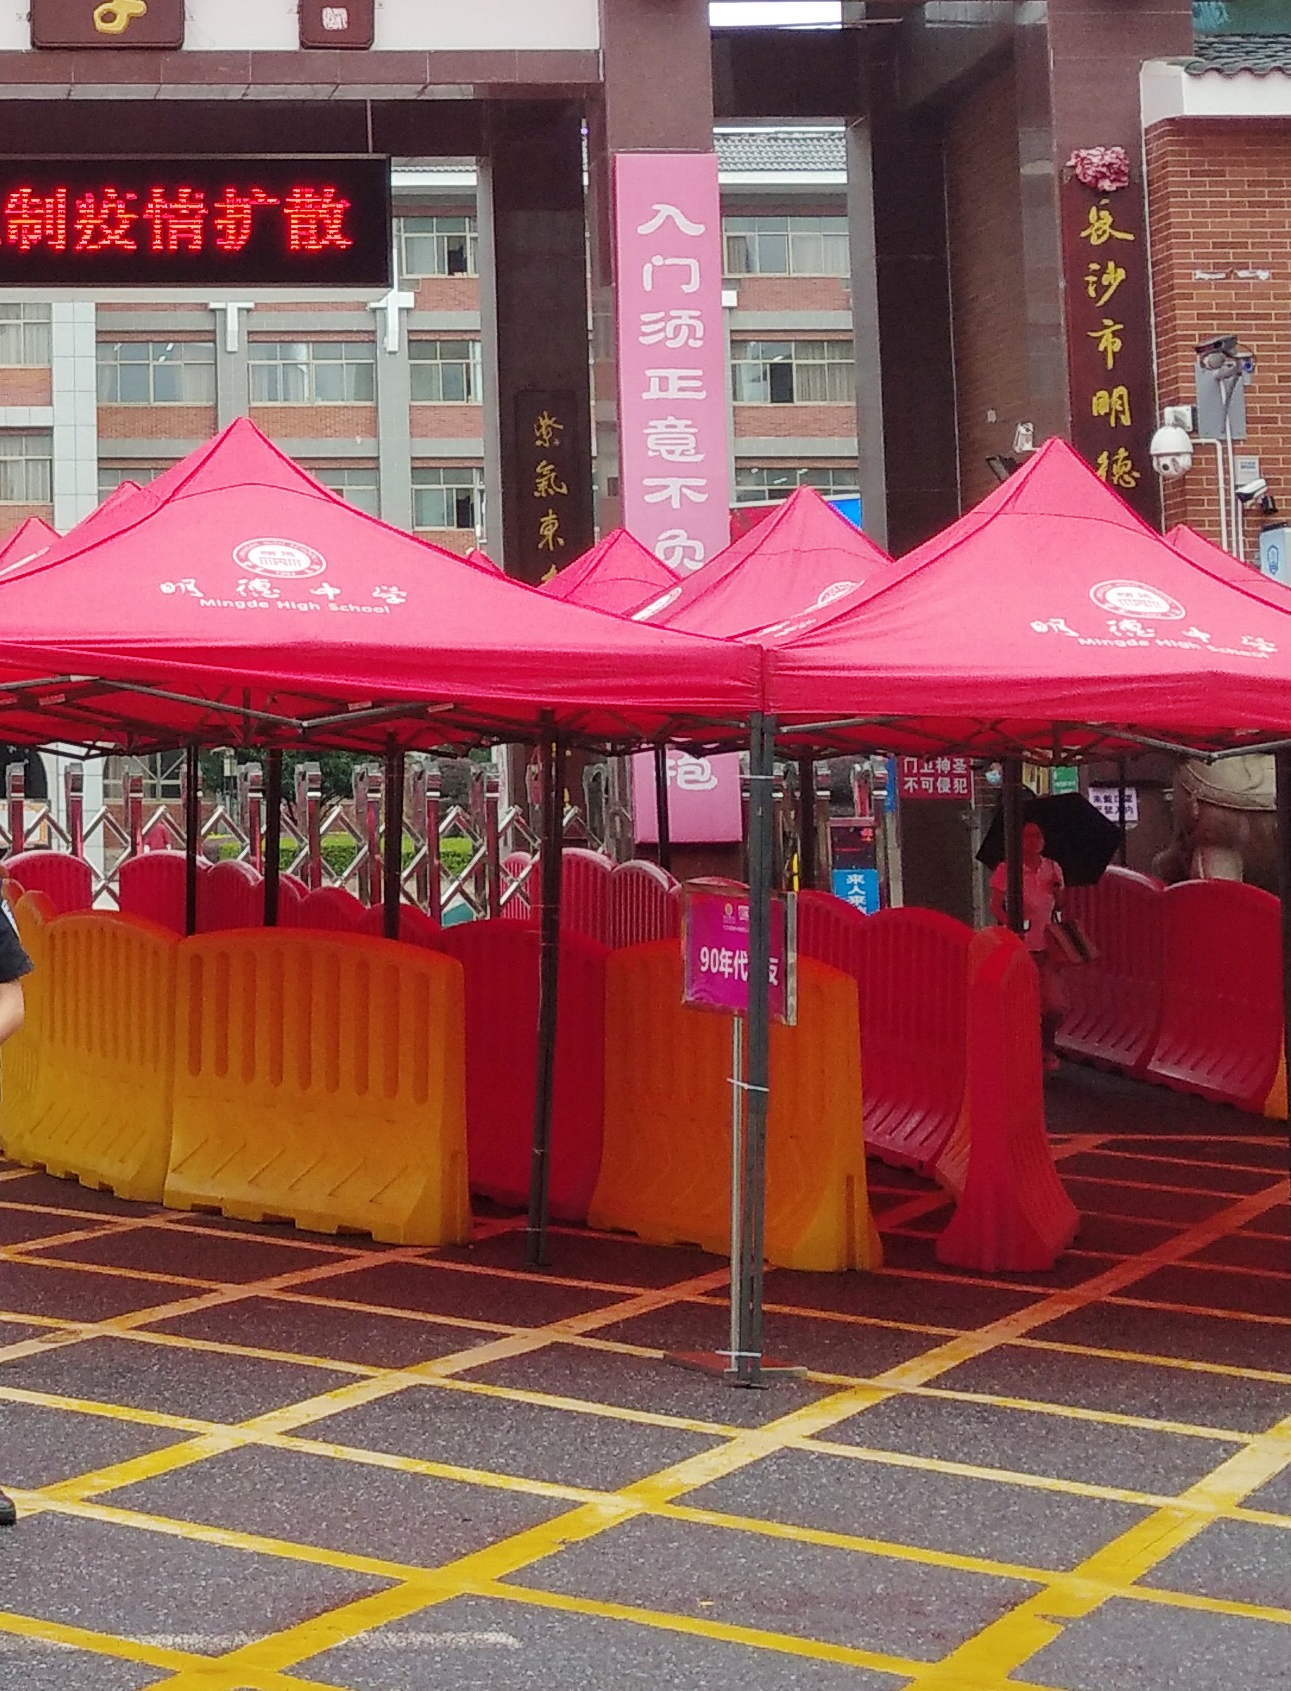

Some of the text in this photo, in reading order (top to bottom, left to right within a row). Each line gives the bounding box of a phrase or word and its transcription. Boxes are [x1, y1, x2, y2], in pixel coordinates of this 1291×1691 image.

[637, 203, 708, 570] 入门须正意不负
[199, 598, 391, 614] Mingde High School
[1077, 637, 1151, 648] Mingde
[1155, 639, 1202, 650] High
[904, 757, 968, 774] 门卫神圣
[904, 777, 968, 794] 不可侵犯
[699, 946, 779, 986] 90年代友
